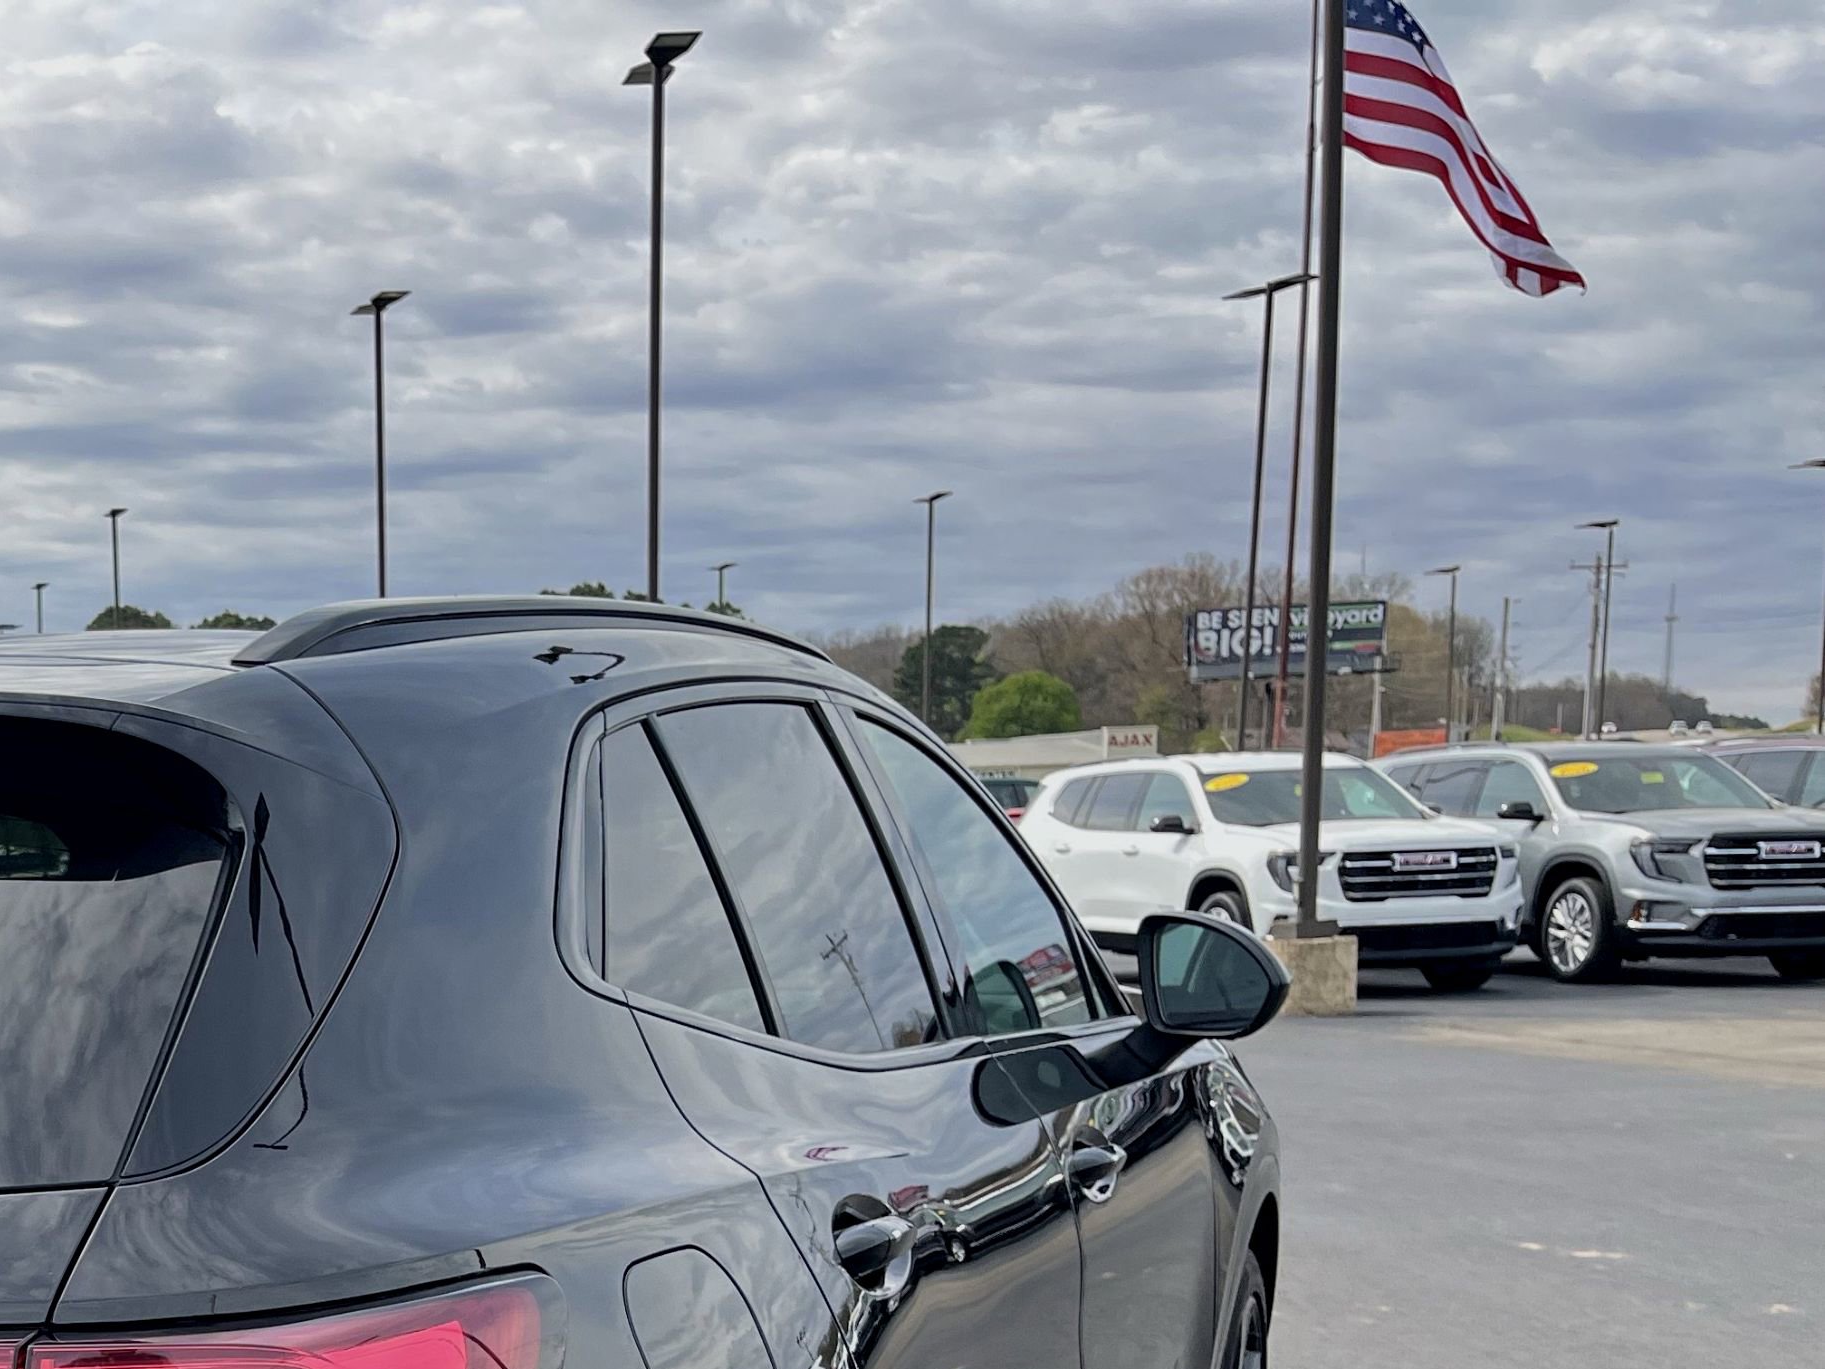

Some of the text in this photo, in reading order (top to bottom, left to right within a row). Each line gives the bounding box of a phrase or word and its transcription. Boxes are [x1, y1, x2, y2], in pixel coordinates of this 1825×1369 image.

[1196, 610, 1223, 630] BE
[1289, 603, 1384, 631] viyard
[1196, 626, 1274, 658] BIG!
[1109, 733, 1154, 748] AJAX
